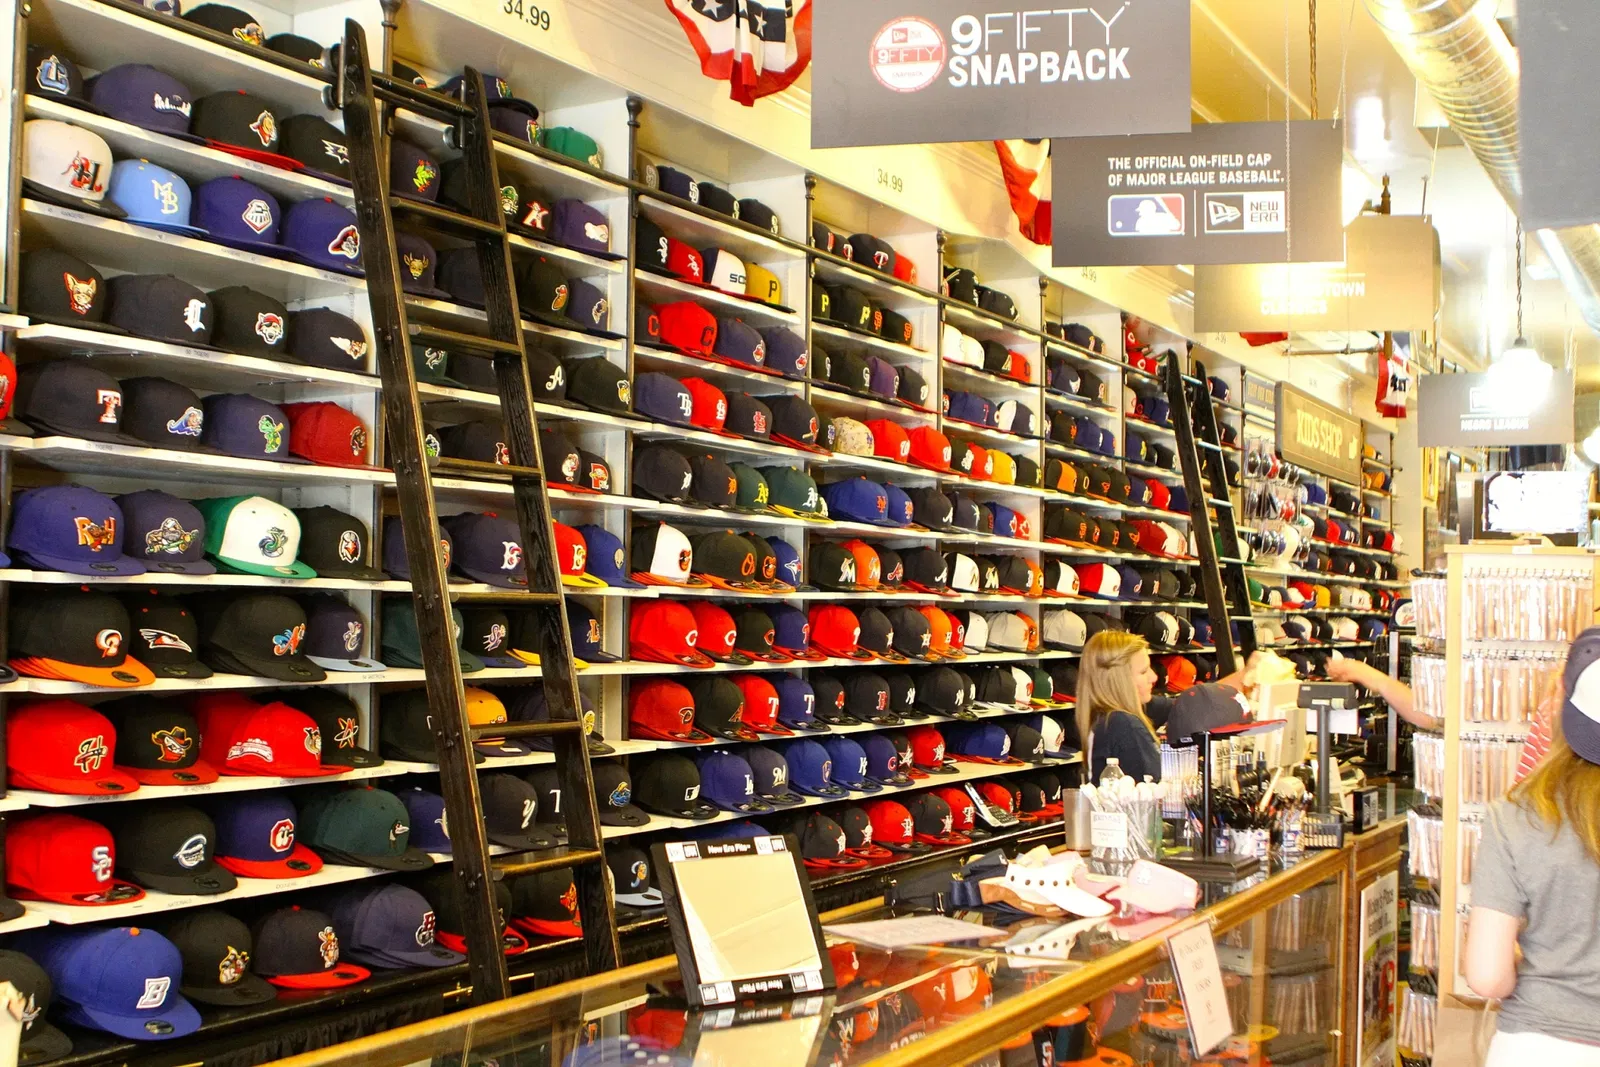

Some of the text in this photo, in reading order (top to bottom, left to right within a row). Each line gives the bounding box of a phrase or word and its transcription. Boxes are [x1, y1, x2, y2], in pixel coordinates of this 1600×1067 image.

[503, 0, 550, 31] 34.99
[948, 46, 1131, 88] SNAPBACK
[1108, 153, 1272, 170] THE OFFICIAL ON-FIELD CAP
[877, 168, 903, 192] 34.99
[1108, 174, 1123, 187] OF
[1127, 173, 1166, 186] MAJOR
[1170, 171, 1216, 185] LEAGUE
[1250, 201, 1278, 211] NEW
[1250, 212, 1278, 222] ERA
[768, 280, 777, 298] P
[821, 294, 829, 312] P
[648, 315, 659, 336] C
[701, 326, 714, 347] C
[1296, 408, 1343, 459] KIDS SHOP
[685, 630, 698, 647] C
[724, 630, 736, 646] C
[768, 697, 779, 718] T
[804, 694, 814, 714] T
[887, 756, 897, 772] C
[136, 976, 171, 1009] B
